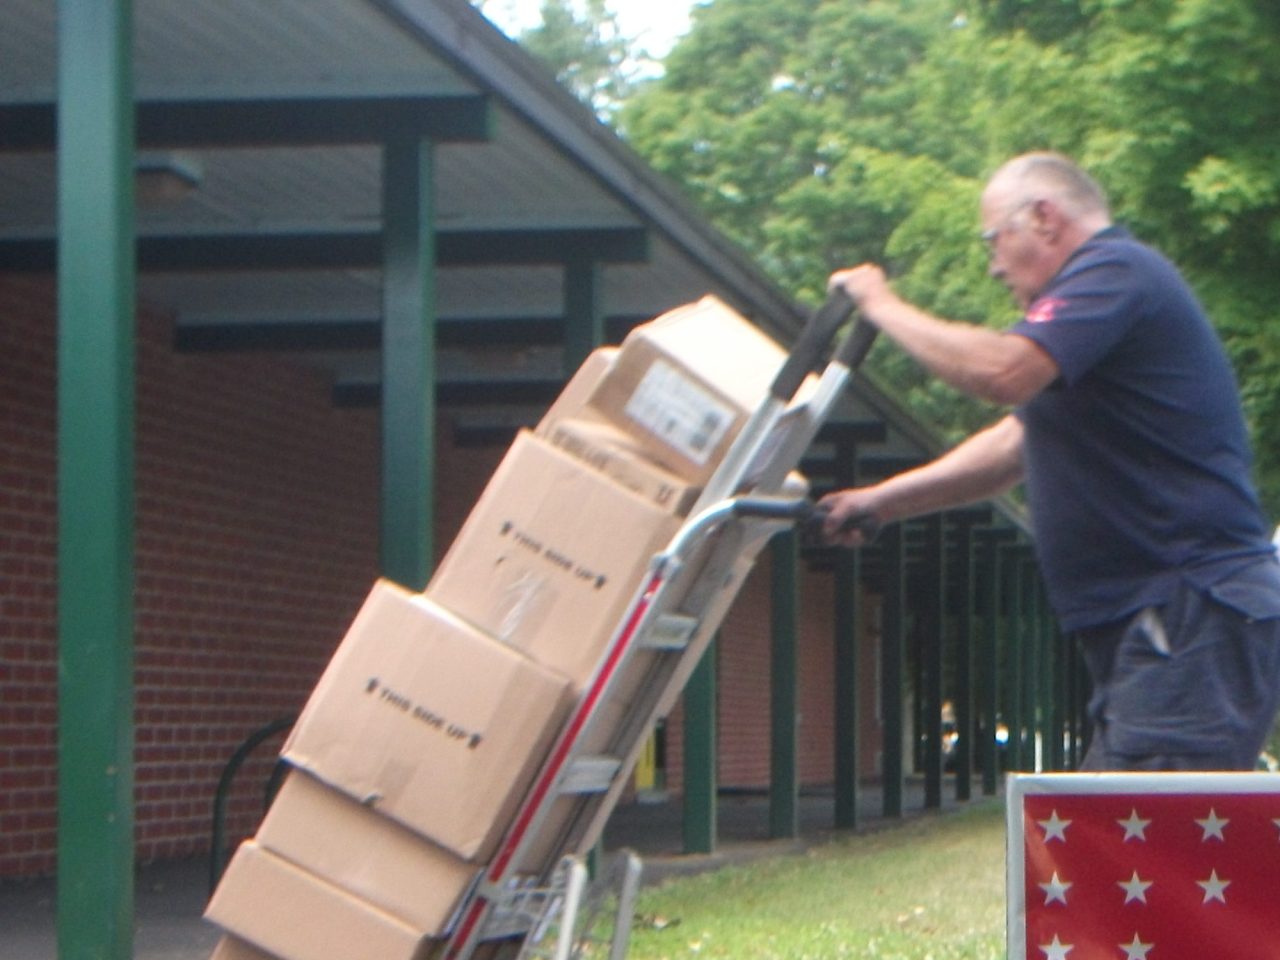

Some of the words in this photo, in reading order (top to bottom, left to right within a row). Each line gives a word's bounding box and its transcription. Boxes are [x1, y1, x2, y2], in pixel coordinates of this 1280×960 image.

[513, 531, 542, 553] THIS
[543, 548, 574, 571] SIDE
[574, 566, 595, 581] UP
[380, 687, 411, 712] THIS
[412, 704, 445, 729] SIDE
[446, 723, 467, 740] UP
